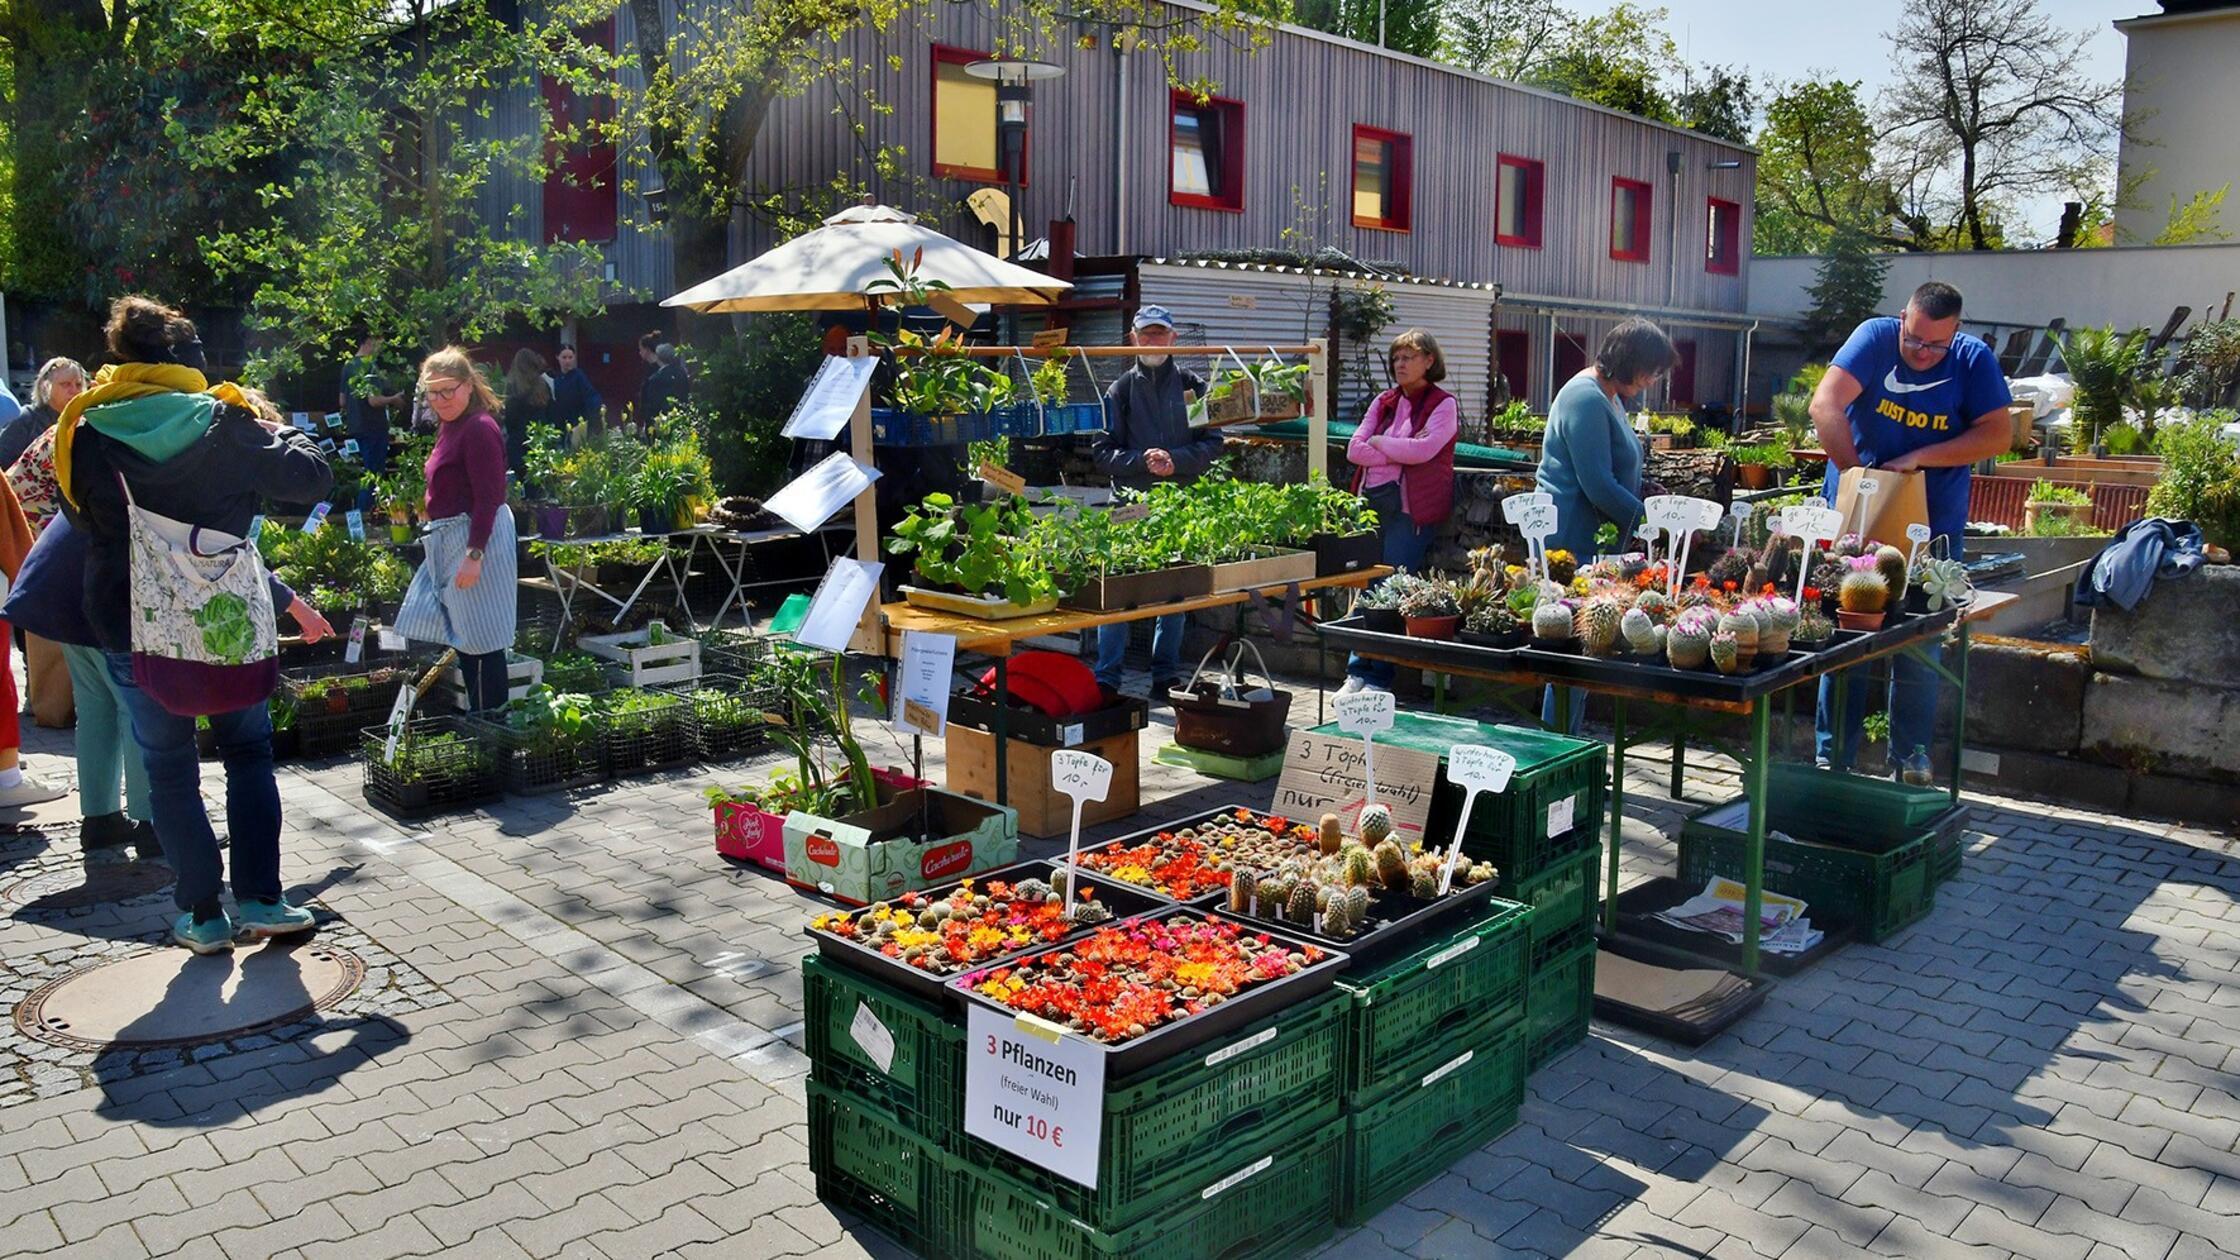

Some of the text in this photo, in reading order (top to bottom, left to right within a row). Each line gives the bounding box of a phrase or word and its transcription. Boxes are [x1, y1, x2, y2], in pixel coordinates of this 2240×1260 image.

[1876, 399, 1949, 430] JUST DO IT.
[1057, 754, 1064, 765] 3
[1300, 740, 1369, 772] 3 Töpf
[1283, 790, 1335, 808] nur
[987, 1035, 1077, 1086] 3 Pflanzen
[1001, 1075, 1059, 1111] (freier Wahl)
[994, 1104, 1063, 1147] nur 10 €
